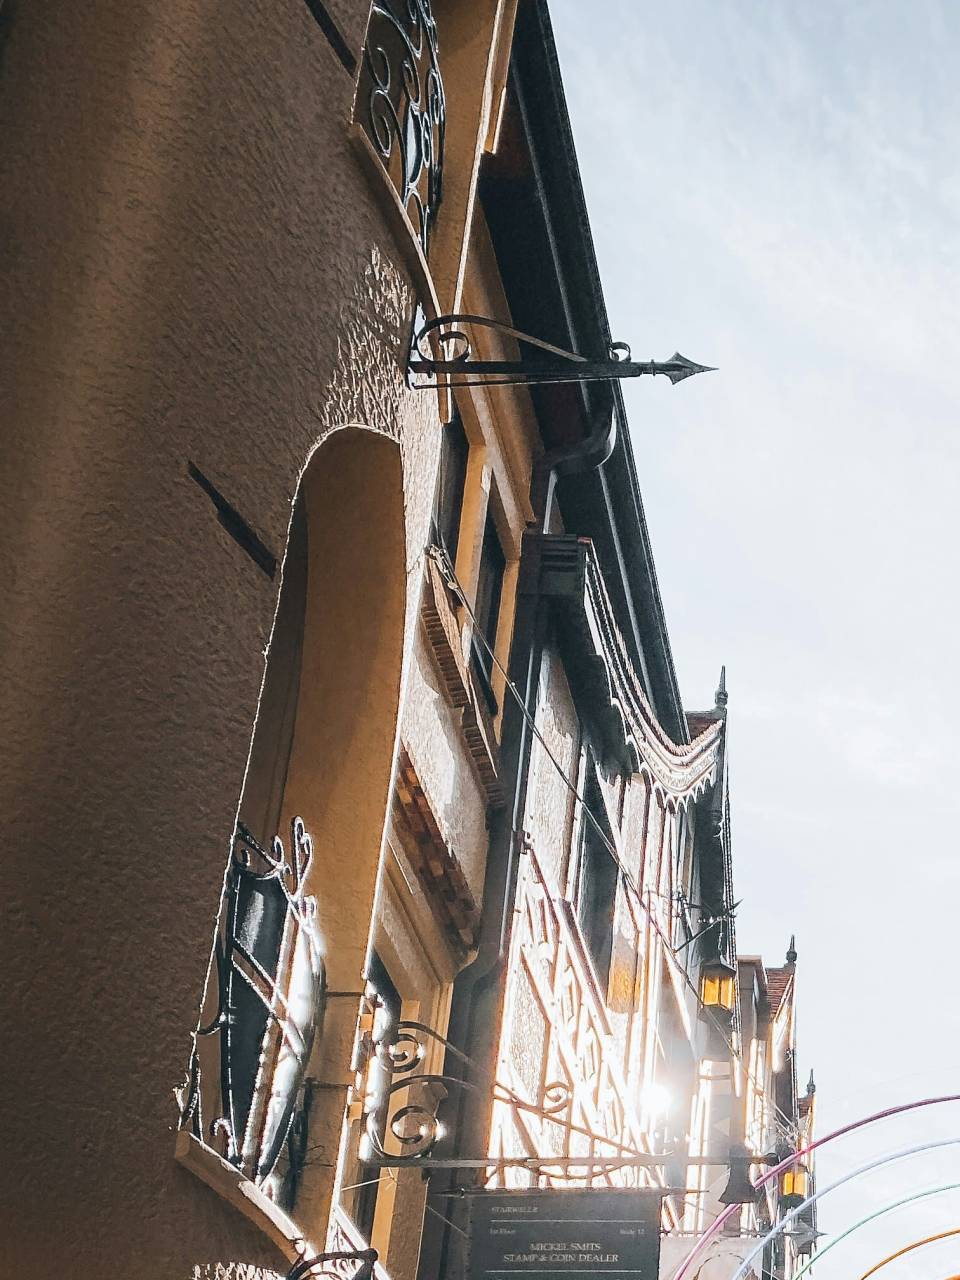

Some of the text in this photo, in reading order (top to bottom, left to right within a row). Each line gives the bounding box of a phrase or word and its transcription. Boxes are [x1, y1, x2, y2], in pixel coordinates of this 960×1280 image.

[571, 1242, 602, 1251] SMITS
[503, 1253, 619, 1263] STAMP & COIN DEALER
